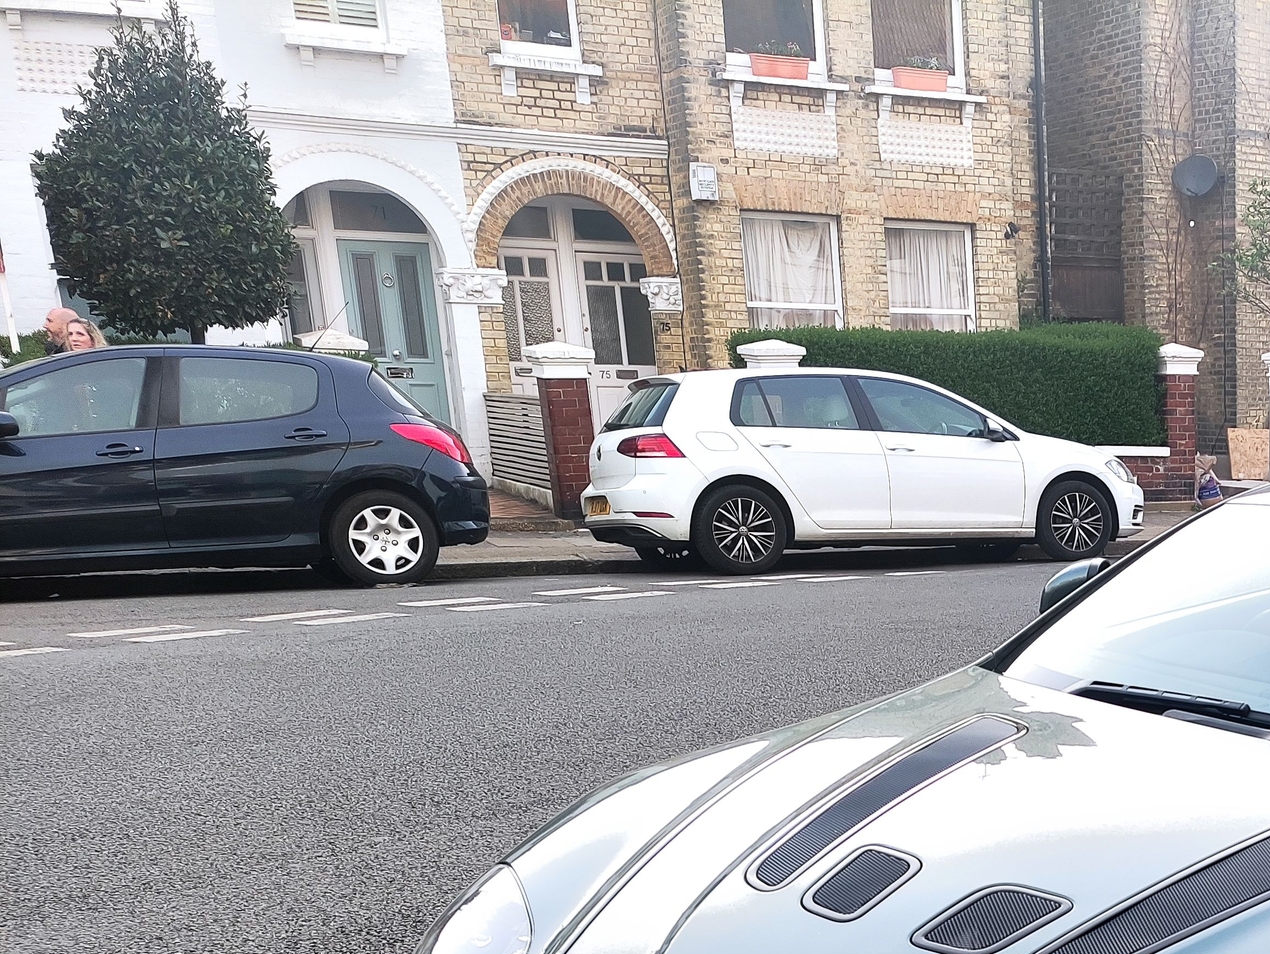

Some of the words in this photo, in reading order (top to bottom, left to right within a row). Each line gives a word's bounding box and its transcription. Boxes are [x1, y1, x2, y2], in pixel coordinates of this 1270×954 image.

[371, 205, 387, 220] 71
[660, 322, 671, 331] 75
[599, 370, 611, 379] 75
